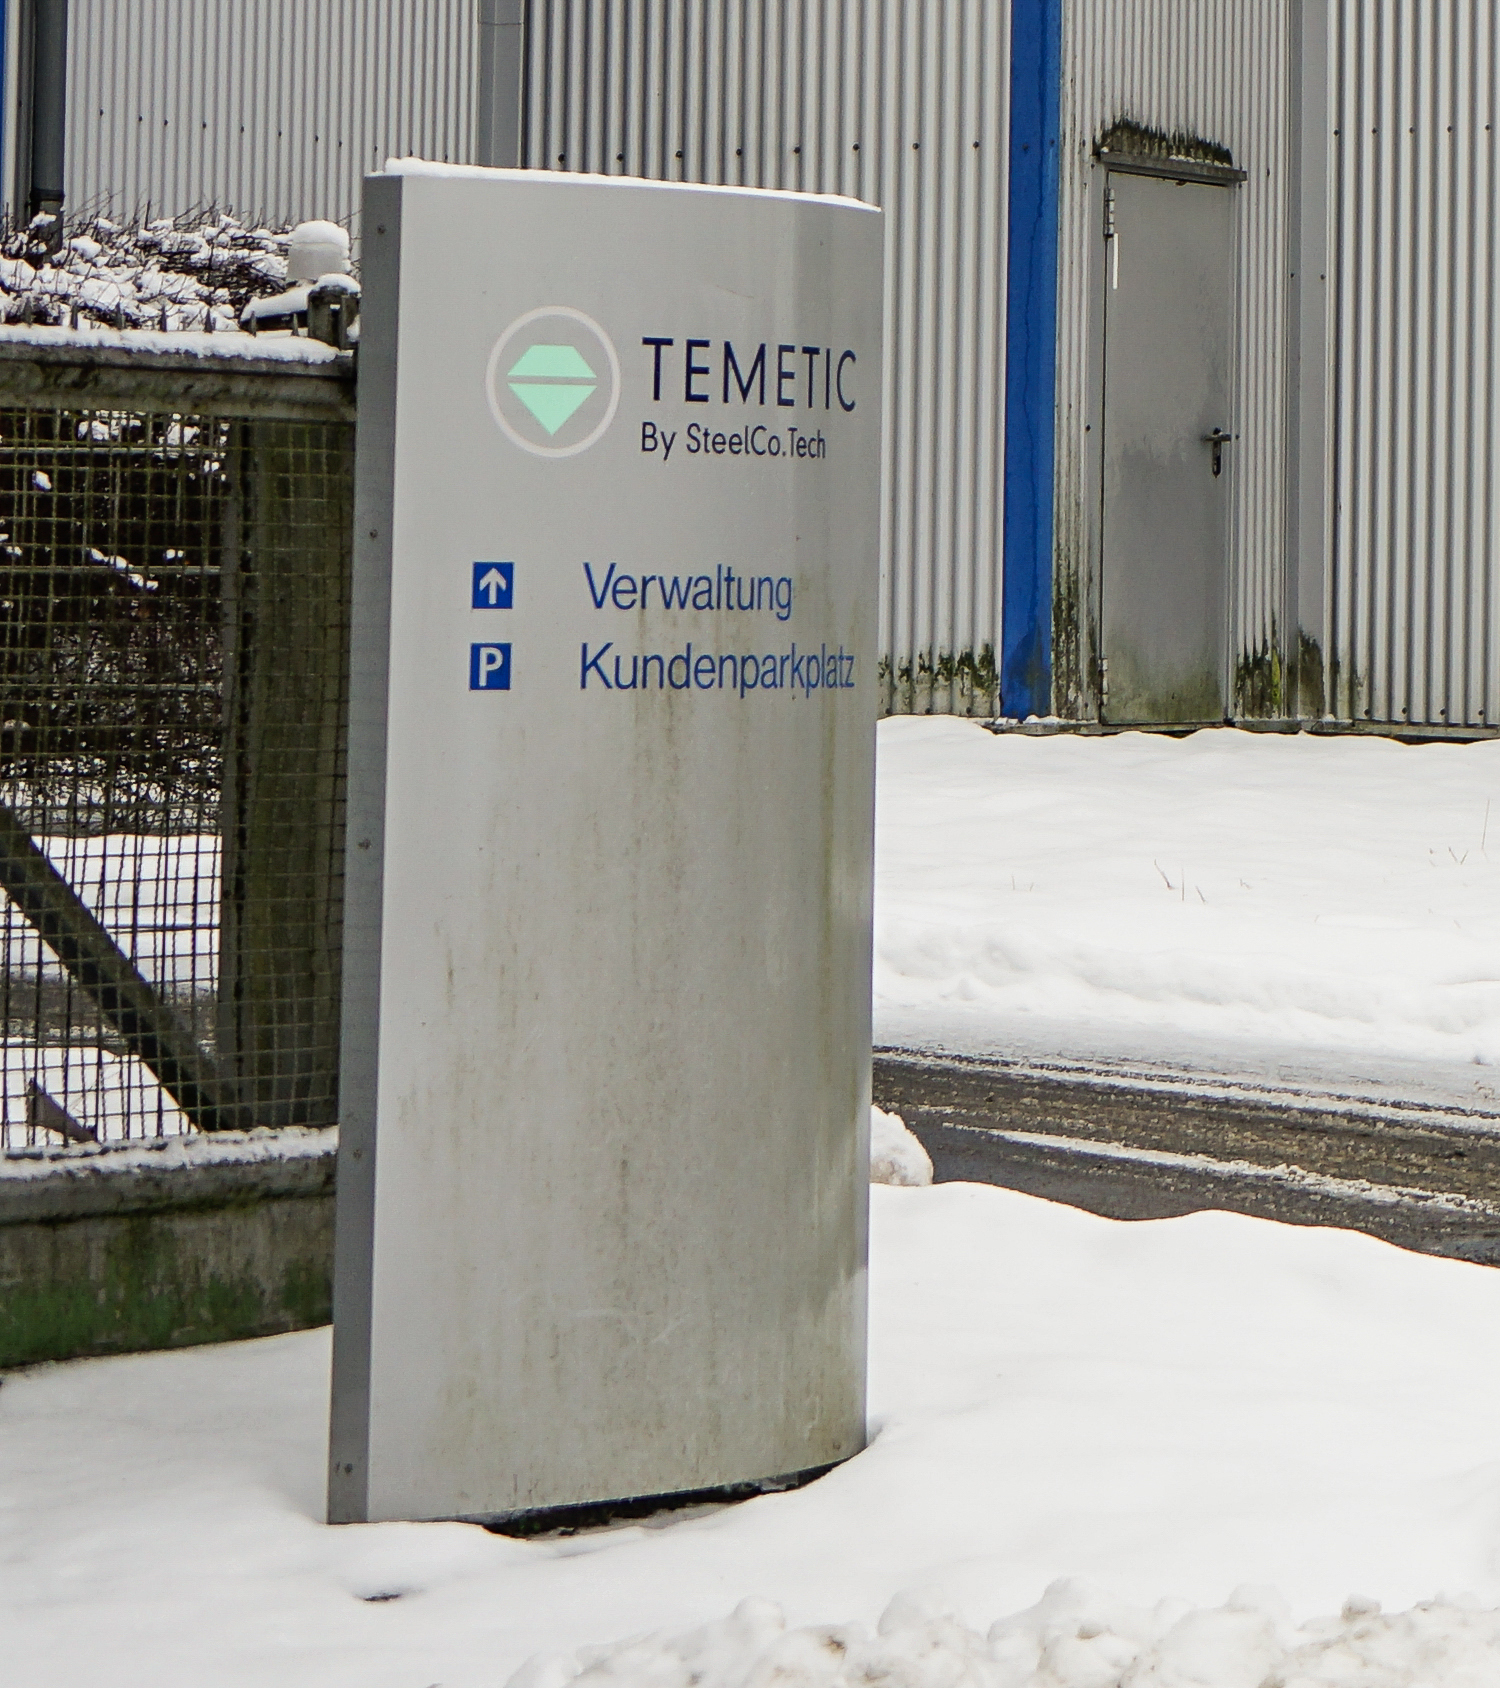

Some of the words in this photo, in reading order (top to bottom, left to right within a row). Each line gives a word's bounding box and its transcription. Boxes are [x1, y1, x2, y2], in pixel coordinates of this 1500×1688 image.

[641, 336, 857, 413] TEMETIC
[641, 421, 677, 461] By
[686, 422, 826, 460] SteelCo.Tech
[584, 562, 793, 622] Verwaltung
[479, 647, 504, 687] P
[580, 642, 855, 700] Kundenparkplatz
